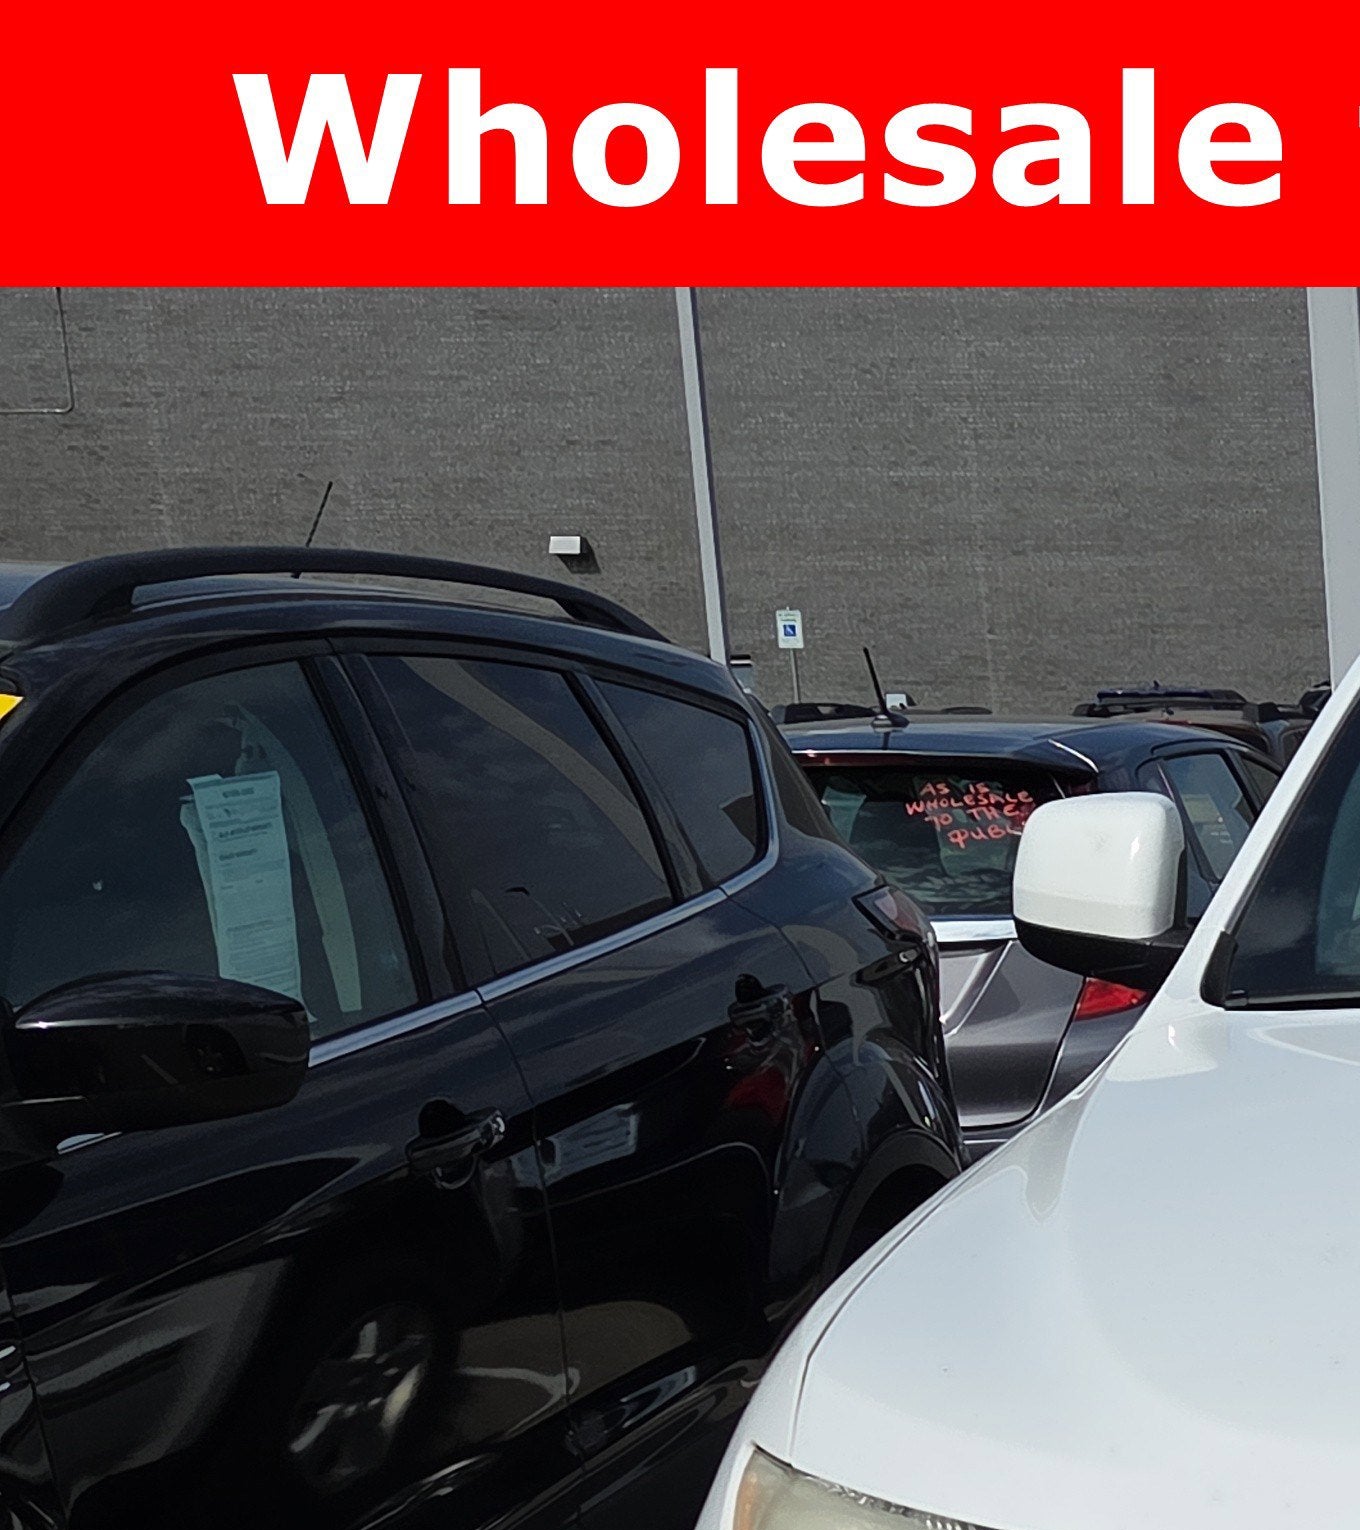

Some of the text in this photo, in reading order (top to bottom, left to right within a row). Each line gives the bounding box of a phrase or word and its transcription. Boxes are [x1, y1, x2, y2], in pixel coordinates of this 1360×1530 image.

[920, 782, 991, 796] AS IS
[924, 804, 1020, 832] TO THE
